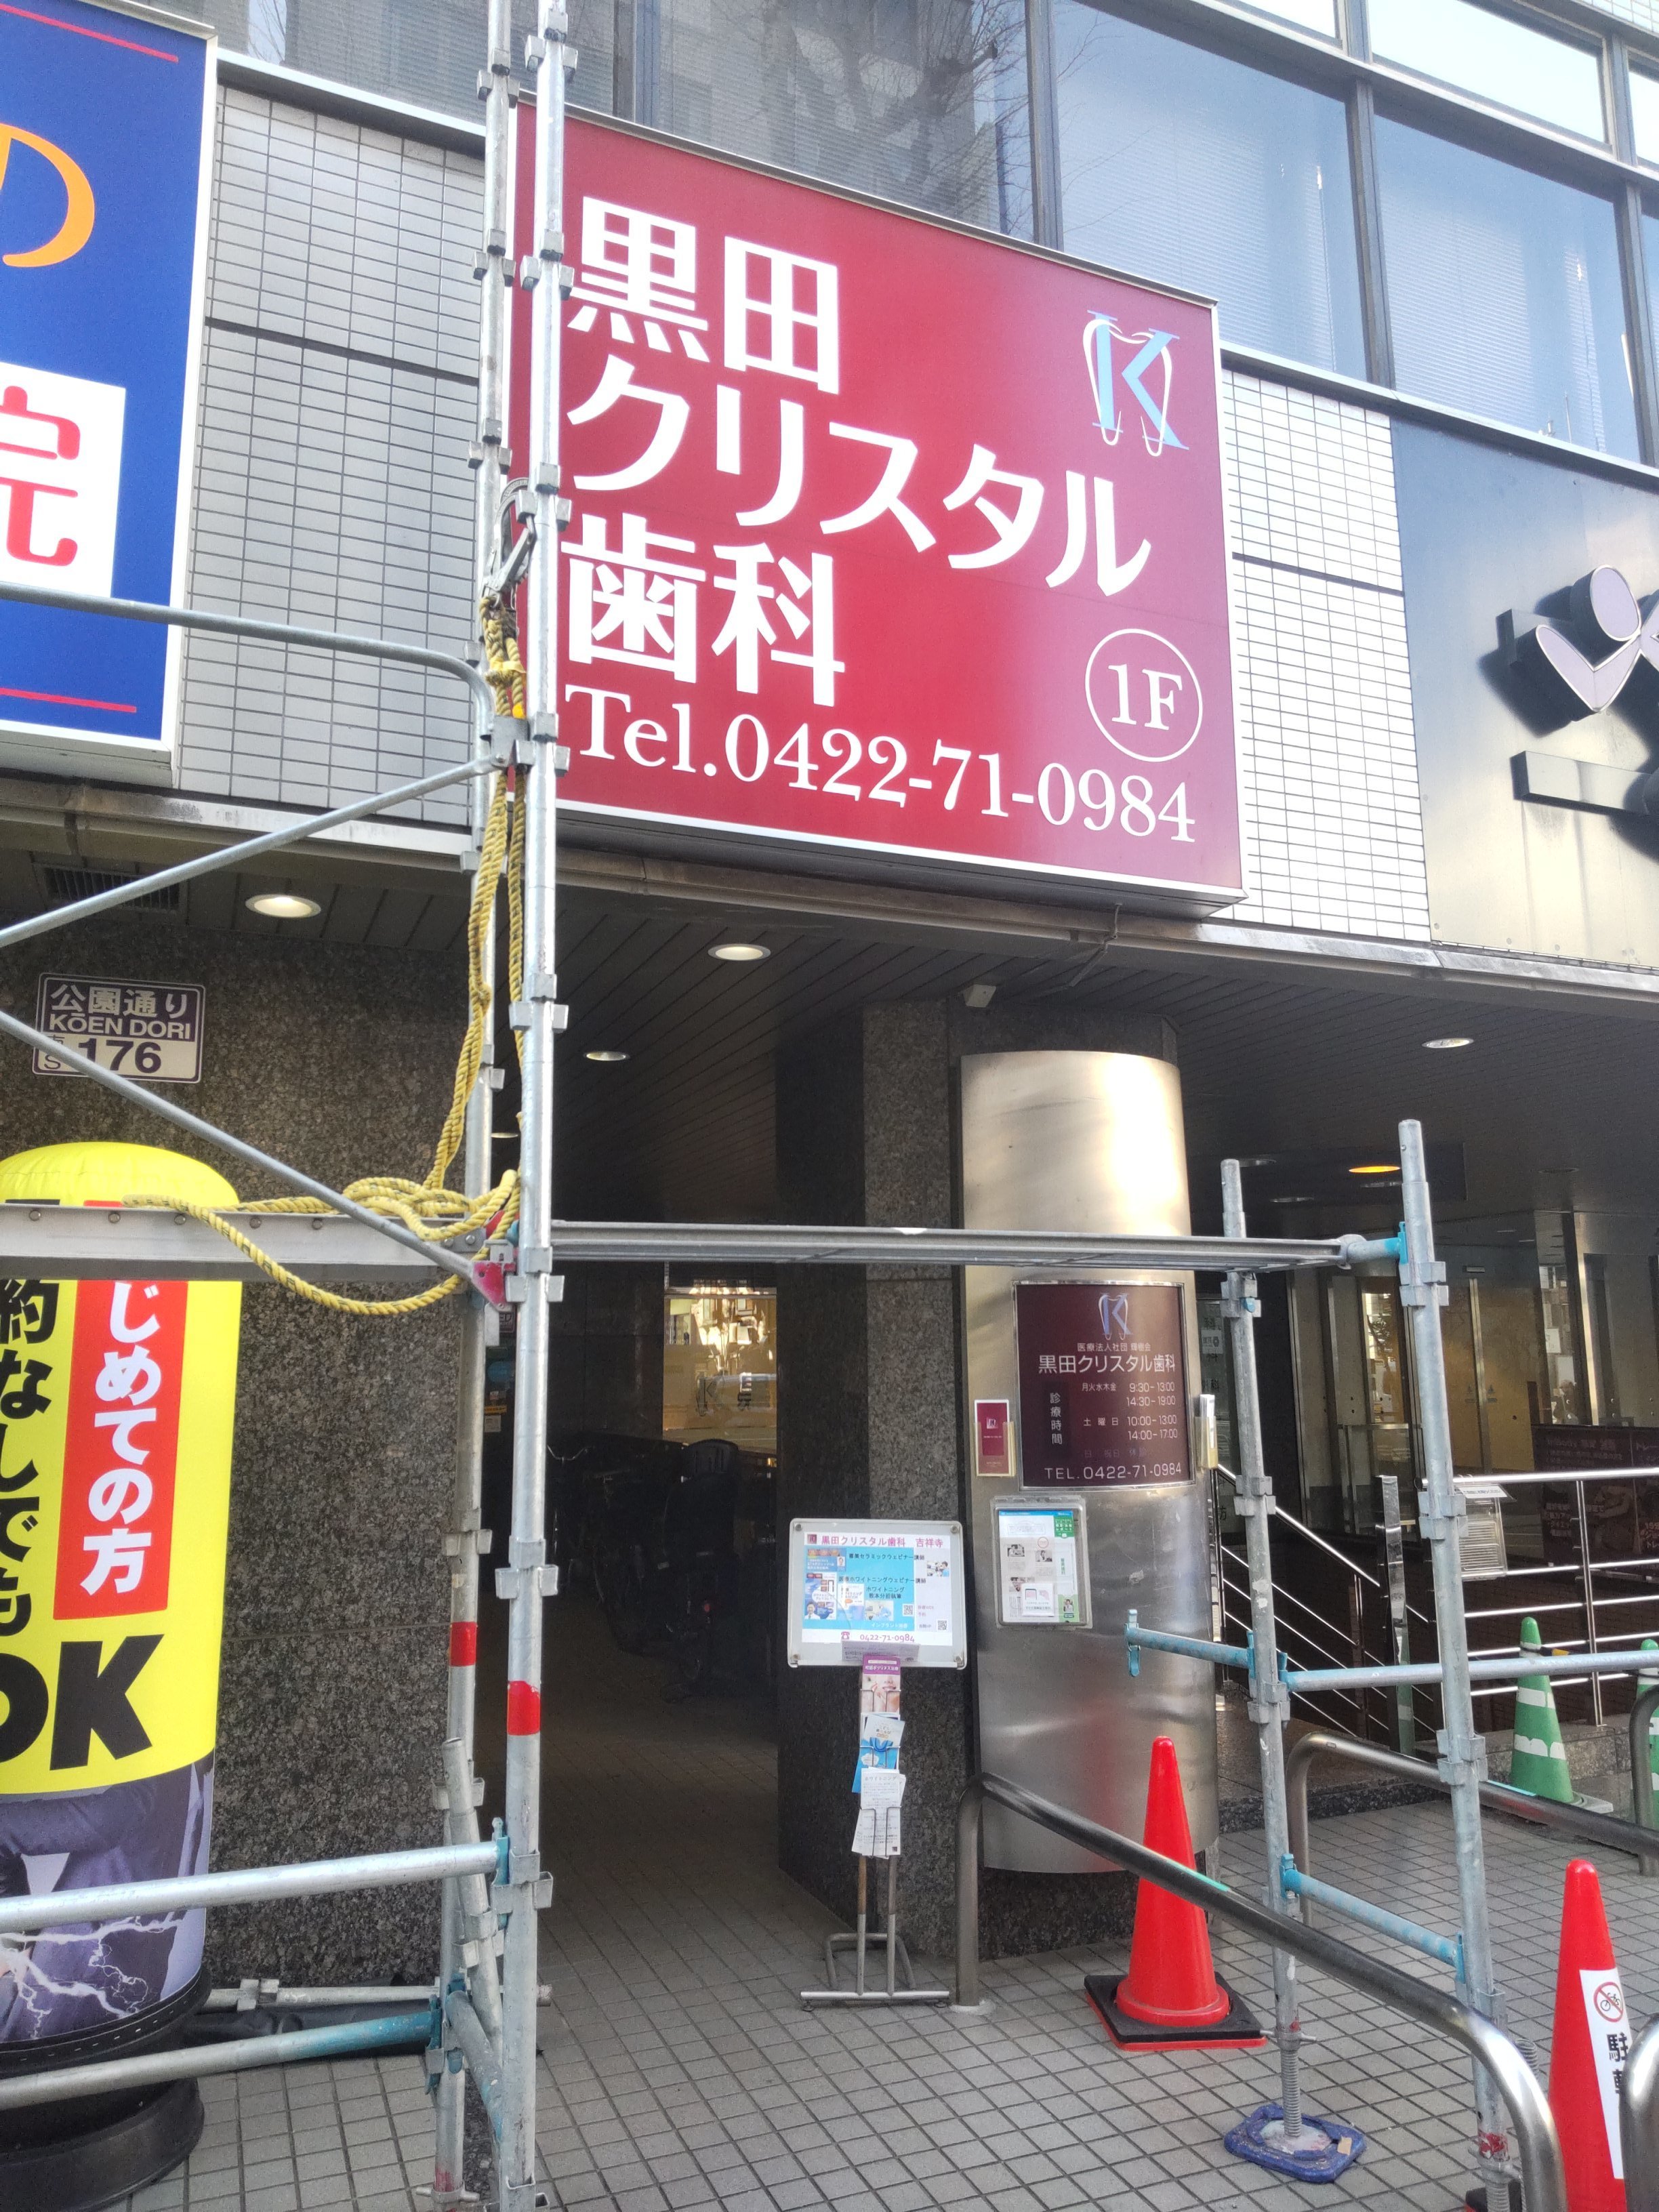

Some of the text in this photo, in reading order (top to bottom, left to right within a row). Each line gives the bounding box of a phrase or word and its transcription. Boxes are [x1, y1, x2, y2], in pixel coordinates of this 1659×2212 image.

[567, 197, 840, 395] 黒田
[567, 354, 1152, 598] クリスタル
[560, 513, 846, 707] 歯科
[1108, 663, 1183, 731] 1F
[50, 983, 188, 1019] 公園通り
[129, 1019, 190, 1040] DORI
[79, 1038, 161, 1073] 176
[1038, 1353, 1176, 1374] 黒田クリスタル歯科
[1078, 1343, 1128, 1352] 医療法人社団
[1082, 1382, 1117, 1392] 月火水木金
[1050, 1392, 1063, 1445] 診療時間
[80, 1280, 161, 1596] じめての方
[821, 1535, 943, 1548] 黒田クリスタル歯科 吉祥寺
